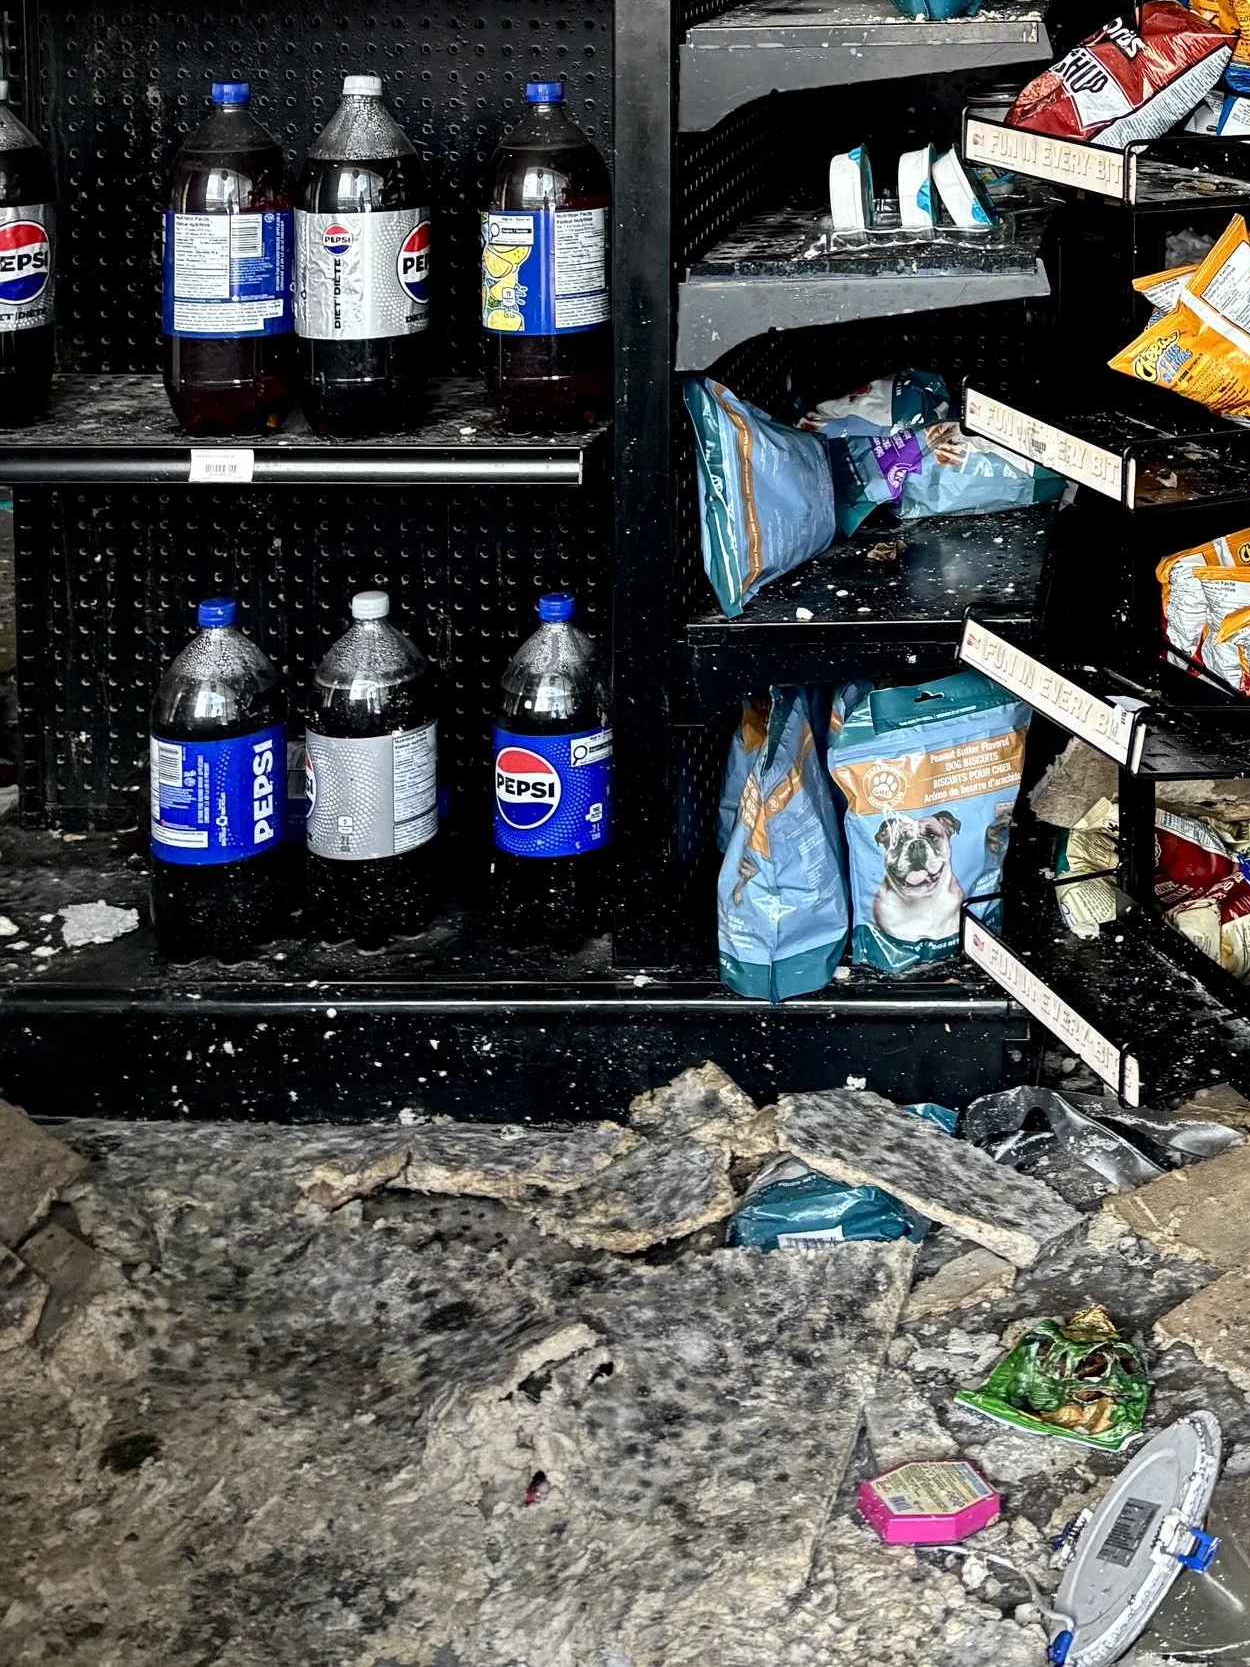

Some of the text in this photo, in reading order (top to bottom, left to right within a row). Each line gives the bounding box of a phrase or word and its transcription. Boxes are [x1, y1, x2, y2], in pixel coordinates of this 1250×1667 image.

[991, 131, 1124, 184] FUN IN EVERY BIT
[0, 251, 48, 272] EPSI
[984, 401, 1120, 484] FUN BIT
[983, 637, 1018, 677] FUN
[1018, 660, 1036, 690] IN
[1038, 674, 1093, 724] EVERY
[930, 737, 1010, 764] Peanut Butter Flavored
[945, 752, 999, 771] DOG BISCUITS
[497, 772, 555, 799] PEPSI
[933, 762, 1012, 789] BISCUITS POUR CHIEN
[253, 739, 274, 844] PEPSI
[924, 790, 948, 803] Arôme
[948, 787, 960, 797] de
[961, 781, 987, 795] beurre
[989, 945, 1017, 986] FUN
[1041, 990, 1093, 1047] EVERY
